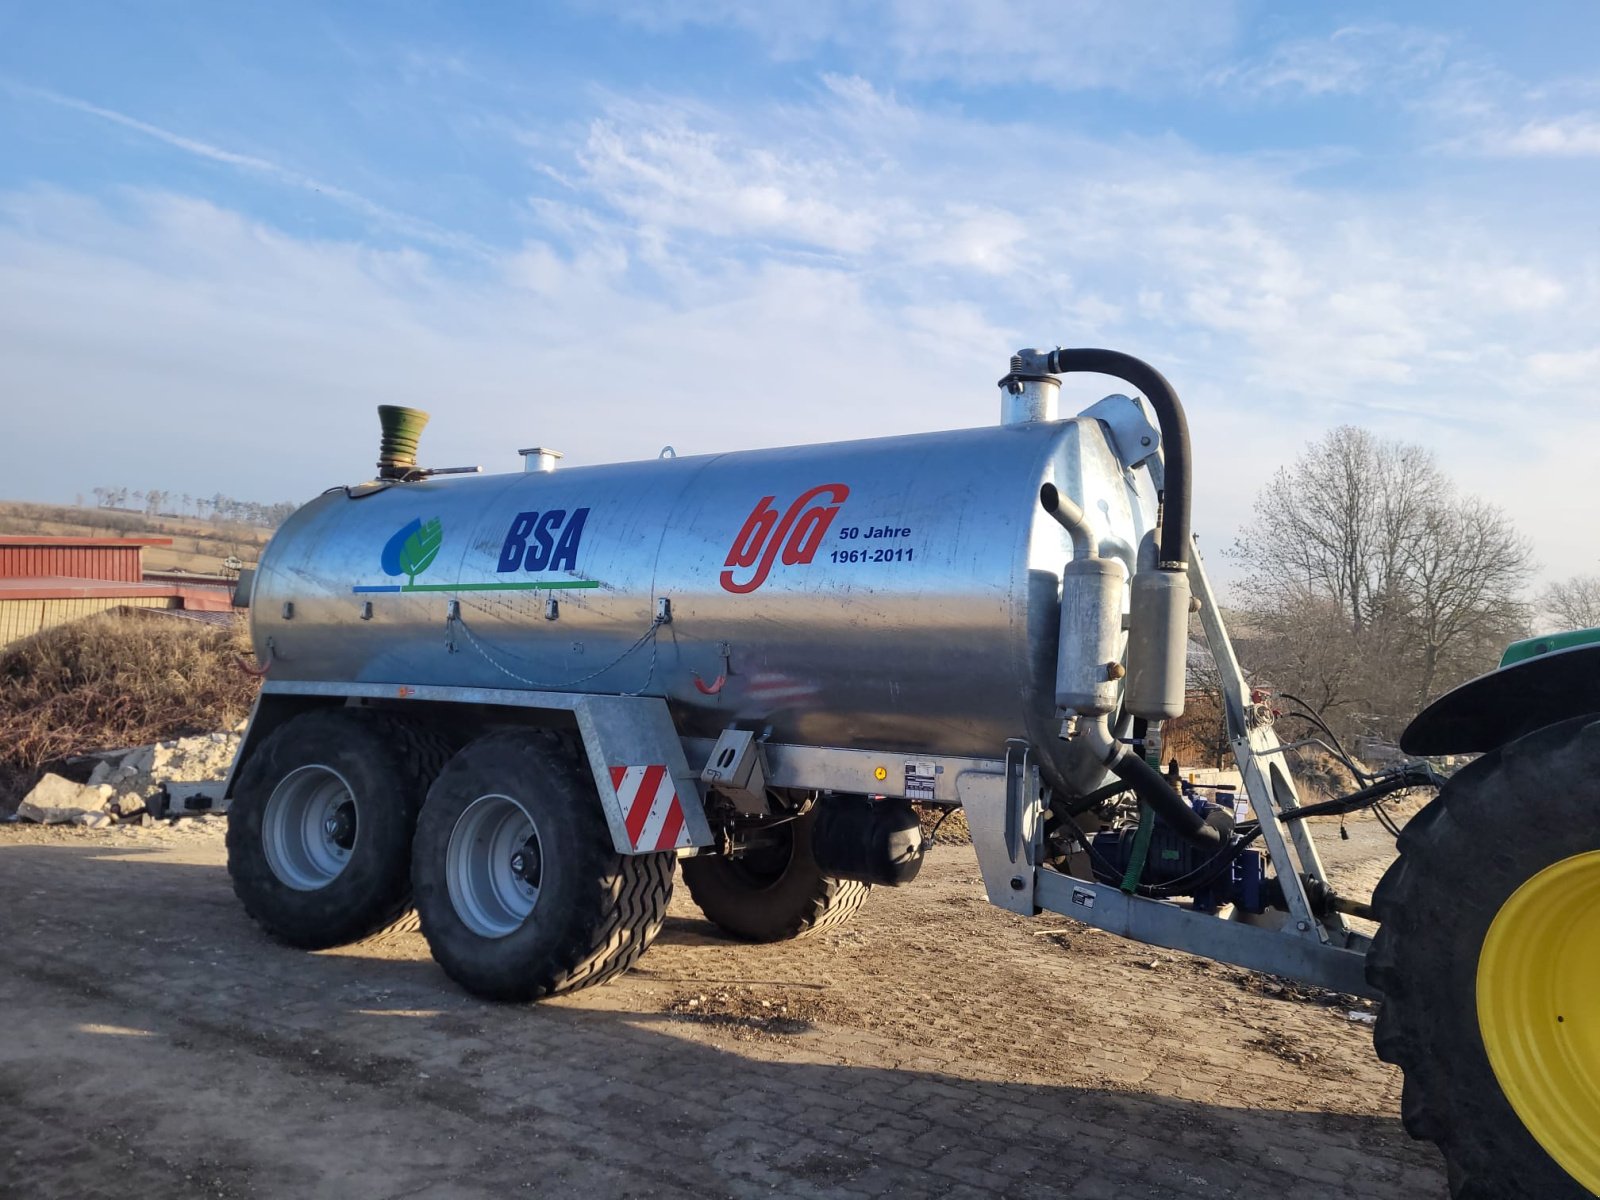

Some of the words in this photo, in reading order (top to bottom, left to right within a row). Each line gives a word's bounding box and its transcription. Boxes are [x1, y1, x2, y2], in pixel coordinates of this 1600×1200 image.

[839, 527, 859, 539] 50
[864, 526, 911, 539] Jahre
[497, 508, 590, 573] BSA
[830, 548, 914, 563] 1961-2011
